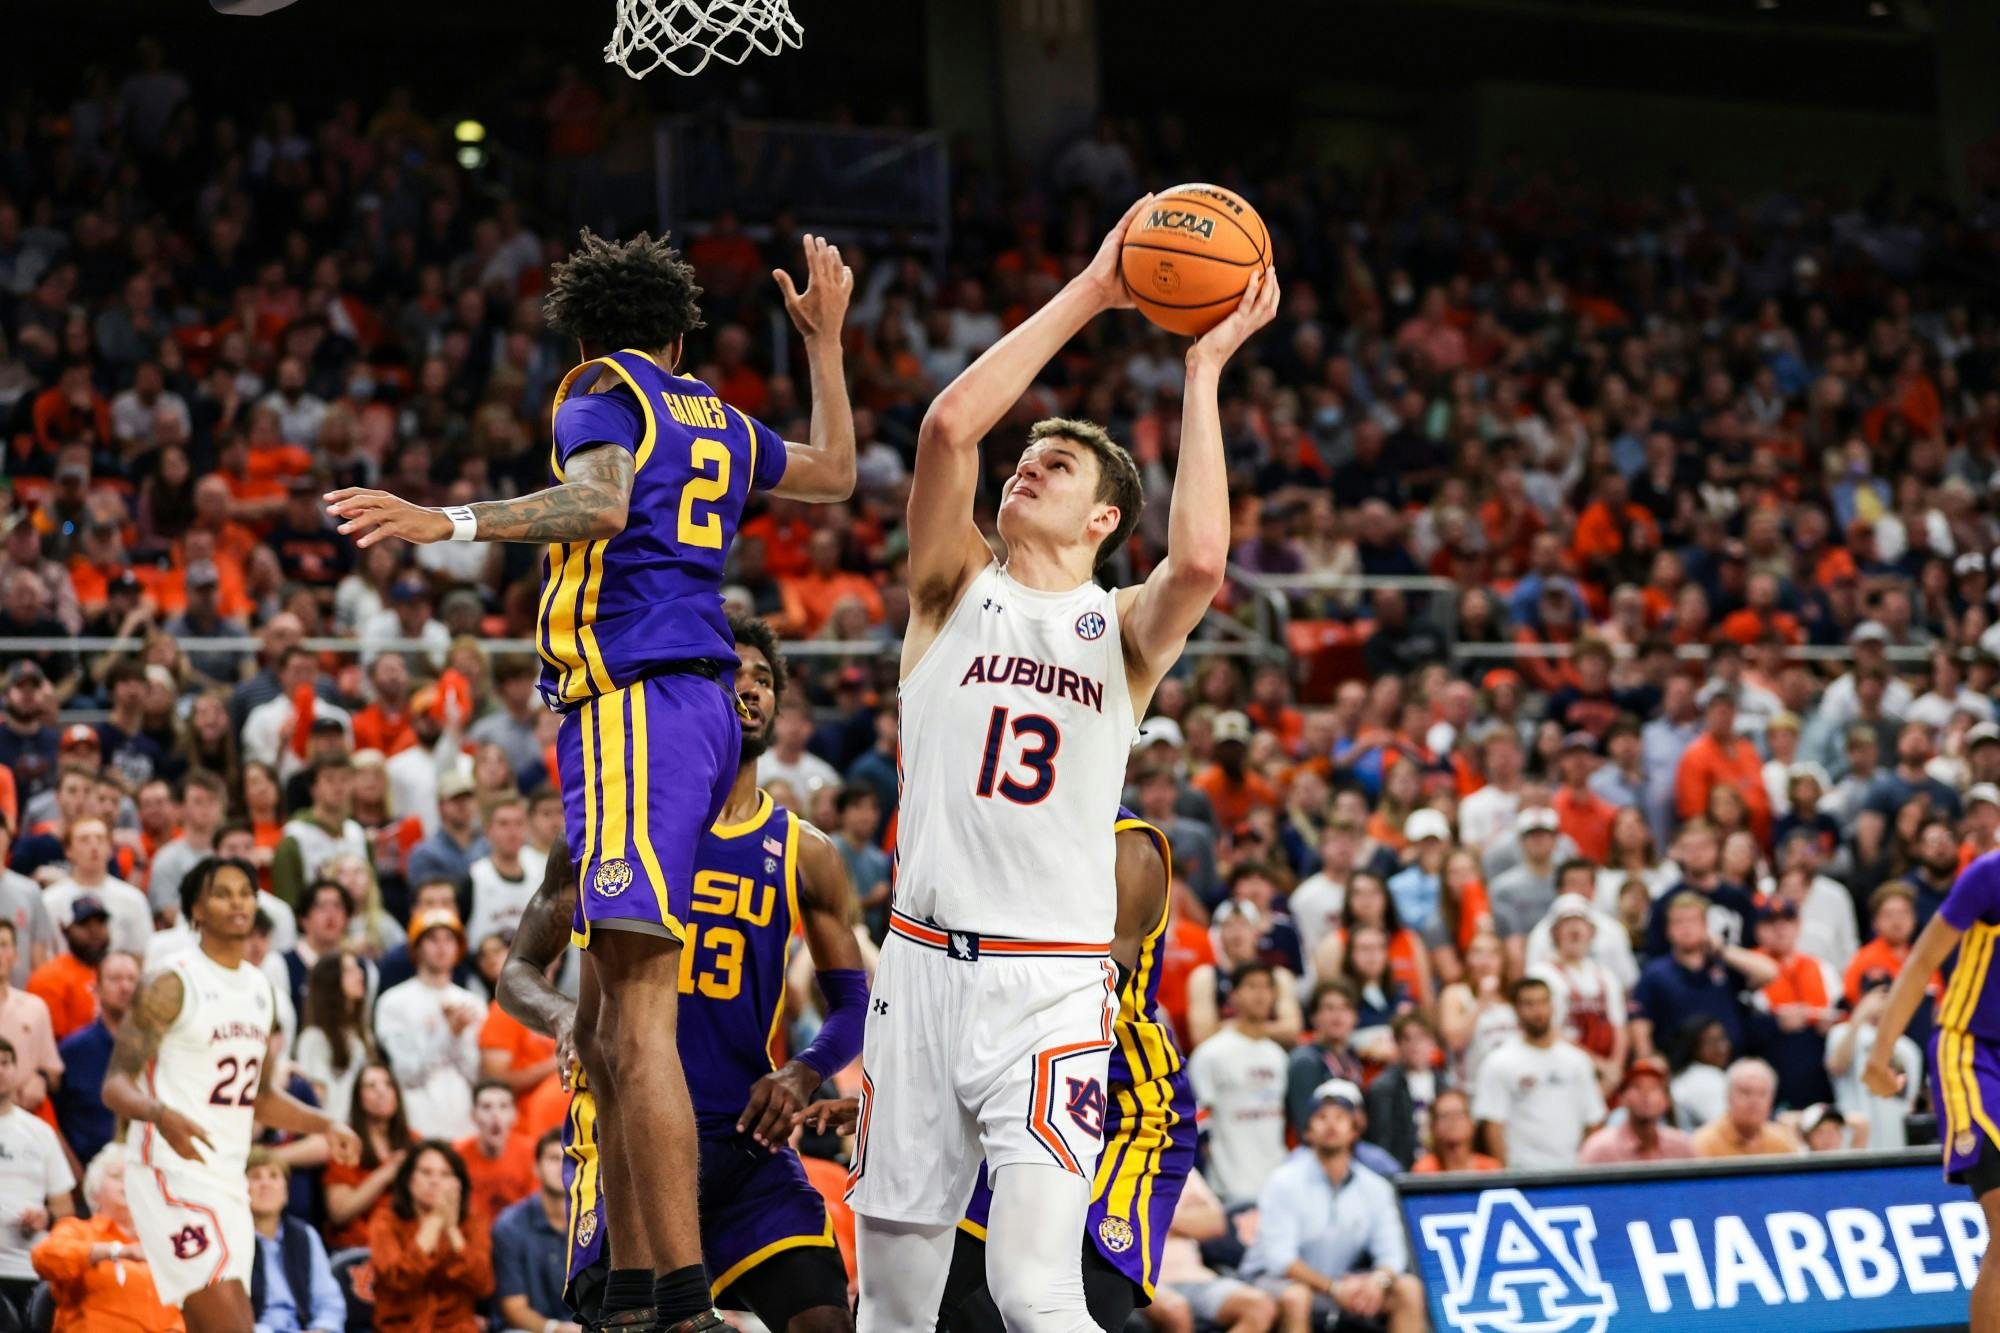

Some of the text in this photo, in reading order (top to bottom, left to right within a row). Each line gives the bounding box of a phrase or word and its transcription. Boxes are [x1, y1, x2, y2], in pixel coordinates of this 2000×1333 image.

[1143, 209, 1216, 241] NCAA
[660, 391, 728, 430] GAINES
[677, 437, 731, 550] 2
[1076, 612, 1106, 640] SEC
[959, 655, 1104, 714] AUBURN
[976, 705, 1061, 805] 13
[691, 869, 777, 928] SU
[677, 922, 747, 1000] 13
[209, 1055, 260, 1107] 22
